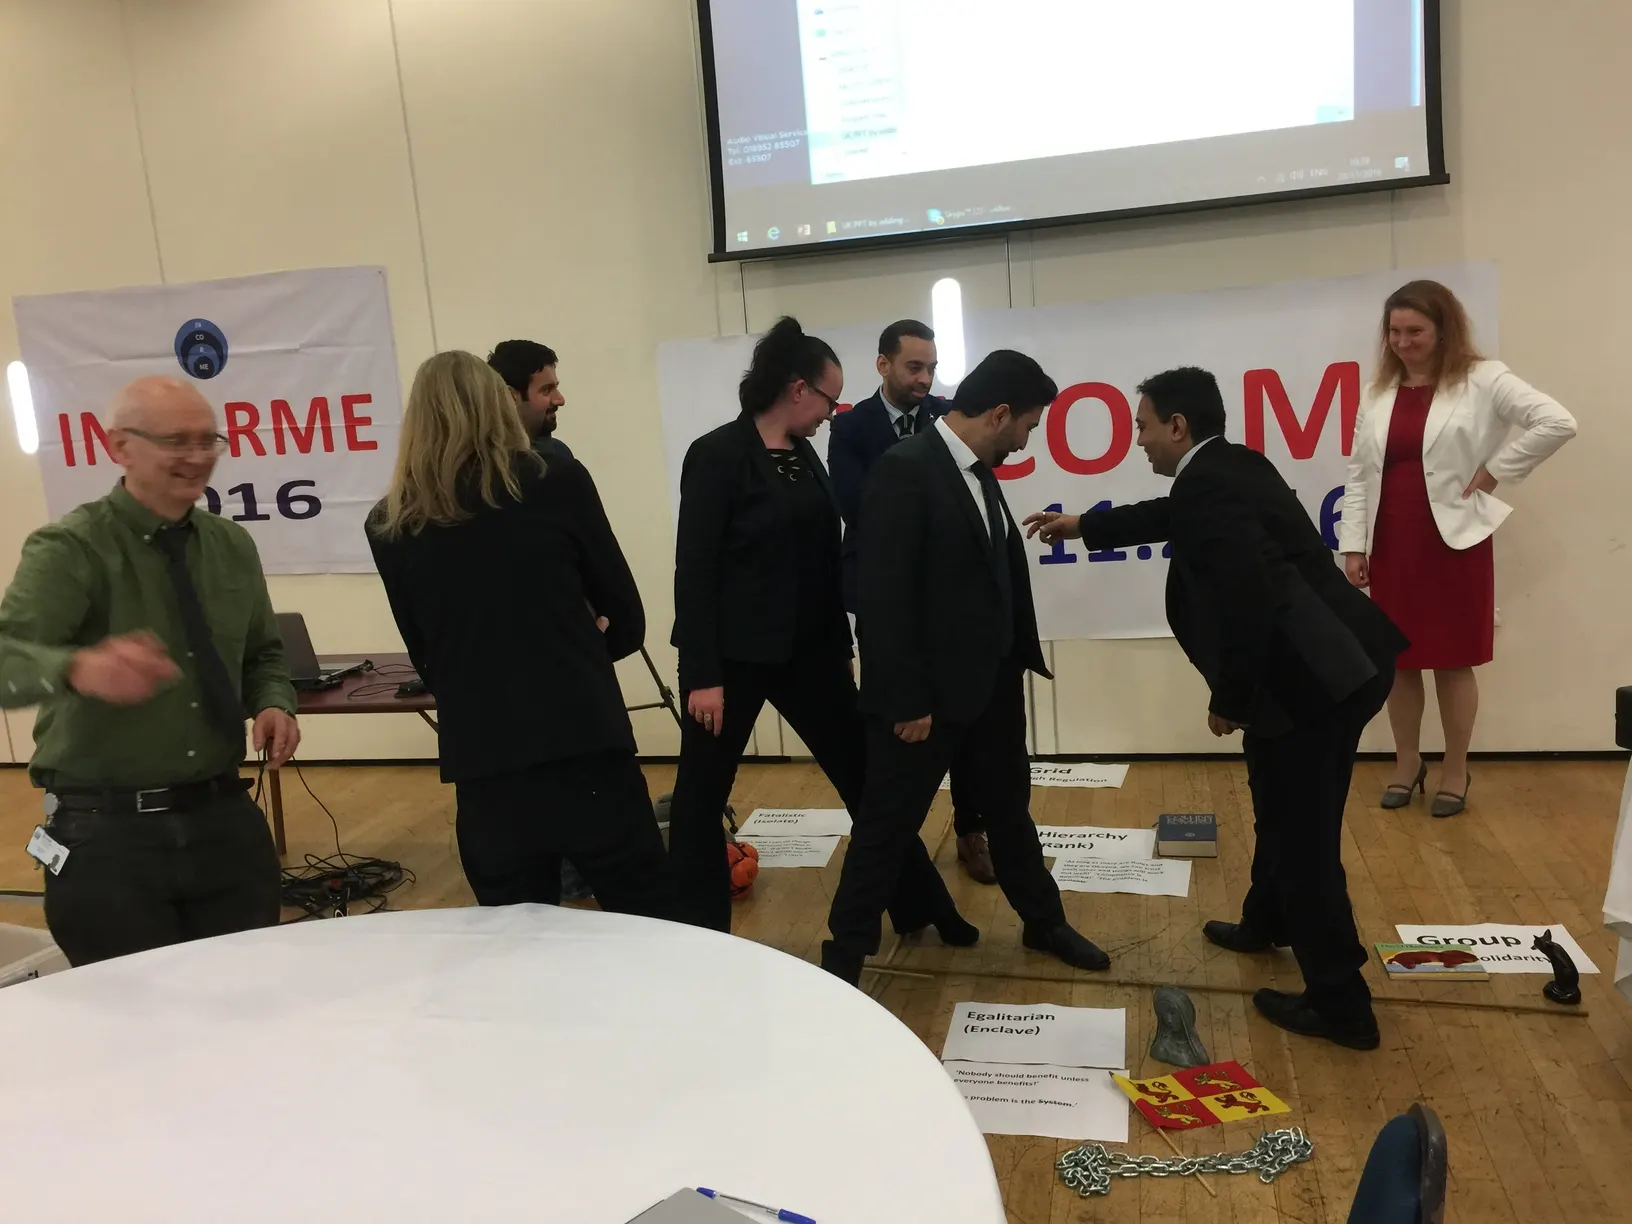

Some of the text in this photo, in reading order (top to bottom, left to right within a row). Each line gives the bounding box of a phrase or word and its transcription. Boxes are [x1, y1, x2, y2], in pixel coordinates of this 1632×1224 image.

[58, 393, 378, 467] INRME
[1030, 766, 1072, 774] Grid
[1038, 830, 1128, 841] Hierarchy
[1041, 841, 1094, 850] Rank)
[1416, 934, 1522, 947] Group
[1477, 953, 1551, 965] olidarity
[967, 1011, 1056, 1022] Egalitarian
[963, 1024, 1041, 1036] (Enclave)
[956, 1069, 992, 1078] 'Nobody
[994, 1071, 1024, 1079] should
[970, 1095, 1009, 1104] problem
